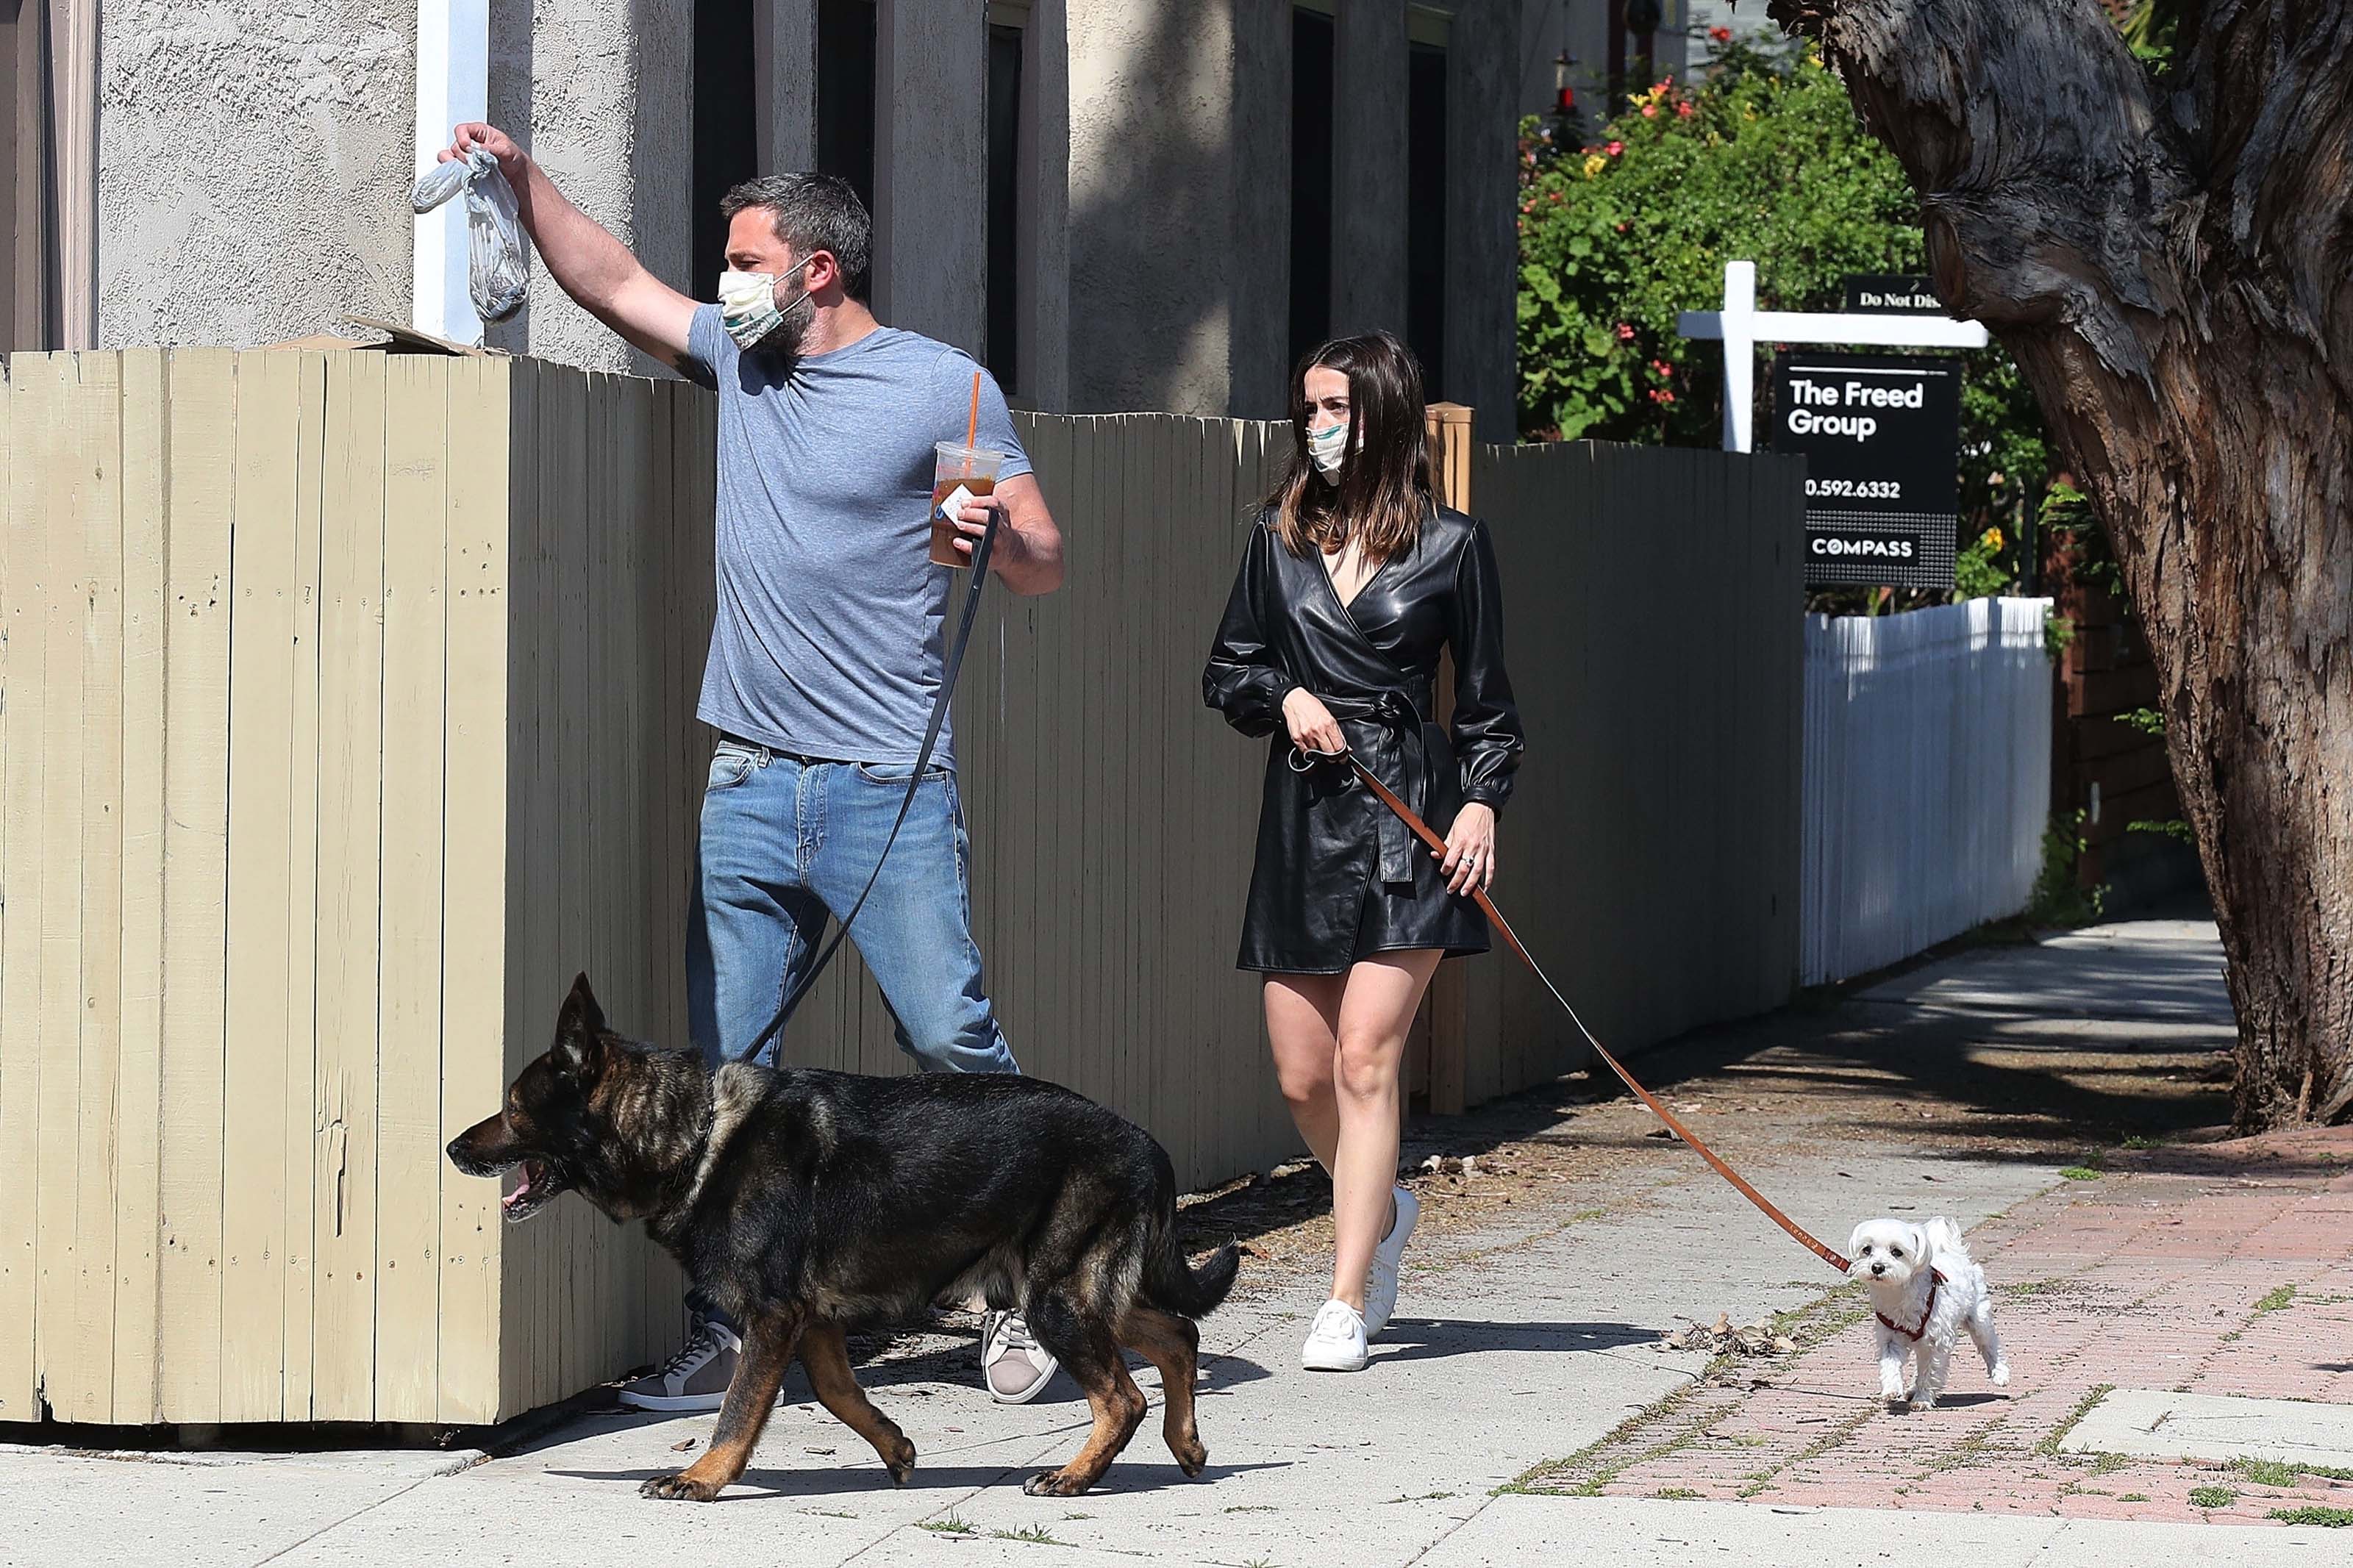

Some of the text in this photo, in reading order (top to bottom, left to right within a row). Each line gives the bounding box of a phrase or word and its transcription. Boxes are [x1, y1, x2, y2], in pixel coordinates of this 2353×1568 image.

[1860, 292, 1882, 307] Do
[1884, 293, 1911, 307] Not
[1788, 379, 1924, 409] The Freed
[1788, 408, 1877, 443] Group
[1804, 479, 1901, 499] 0.592.6332
[1812, 538, 1913, 558] COMPASS
